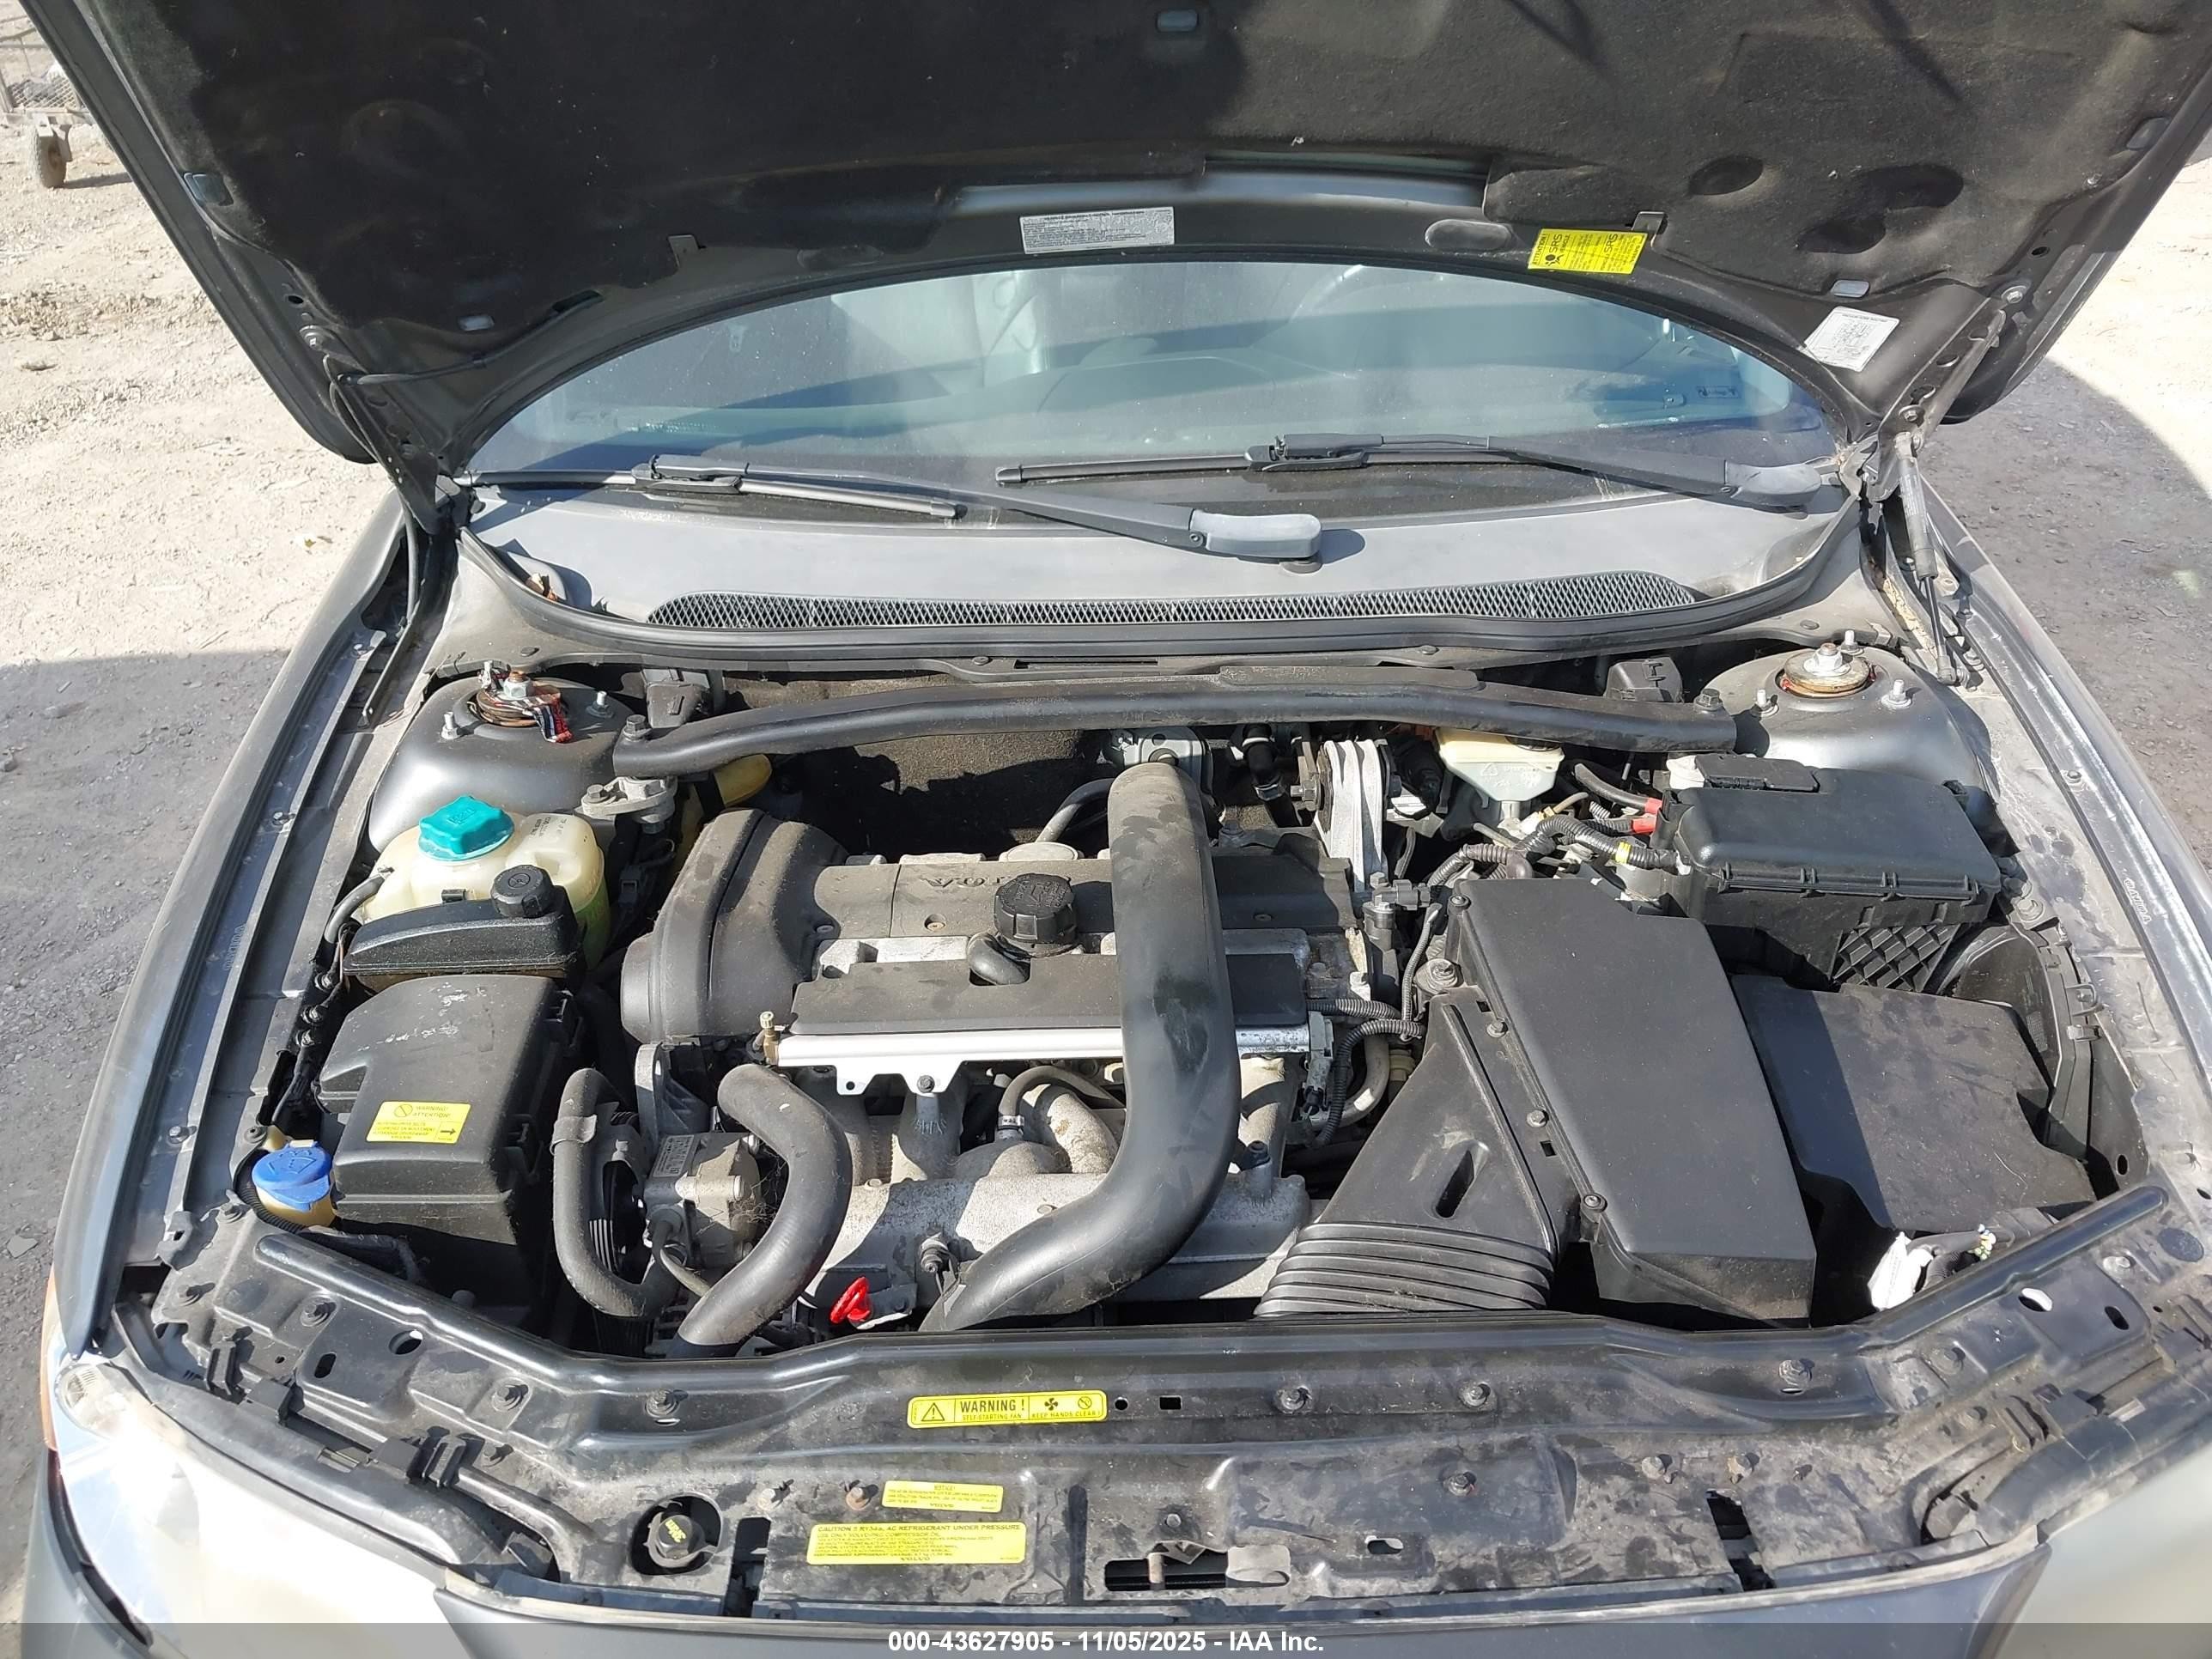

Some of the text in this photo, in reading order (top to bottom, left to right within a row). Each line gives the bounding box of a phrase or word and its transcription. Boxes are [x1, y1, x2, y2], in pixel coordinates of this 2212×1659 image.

[1549, 234, 1563, 253] SRS
[1604, 234, 1619, 252] SRS
[960, 1399, 1016, 1413] WARNING
